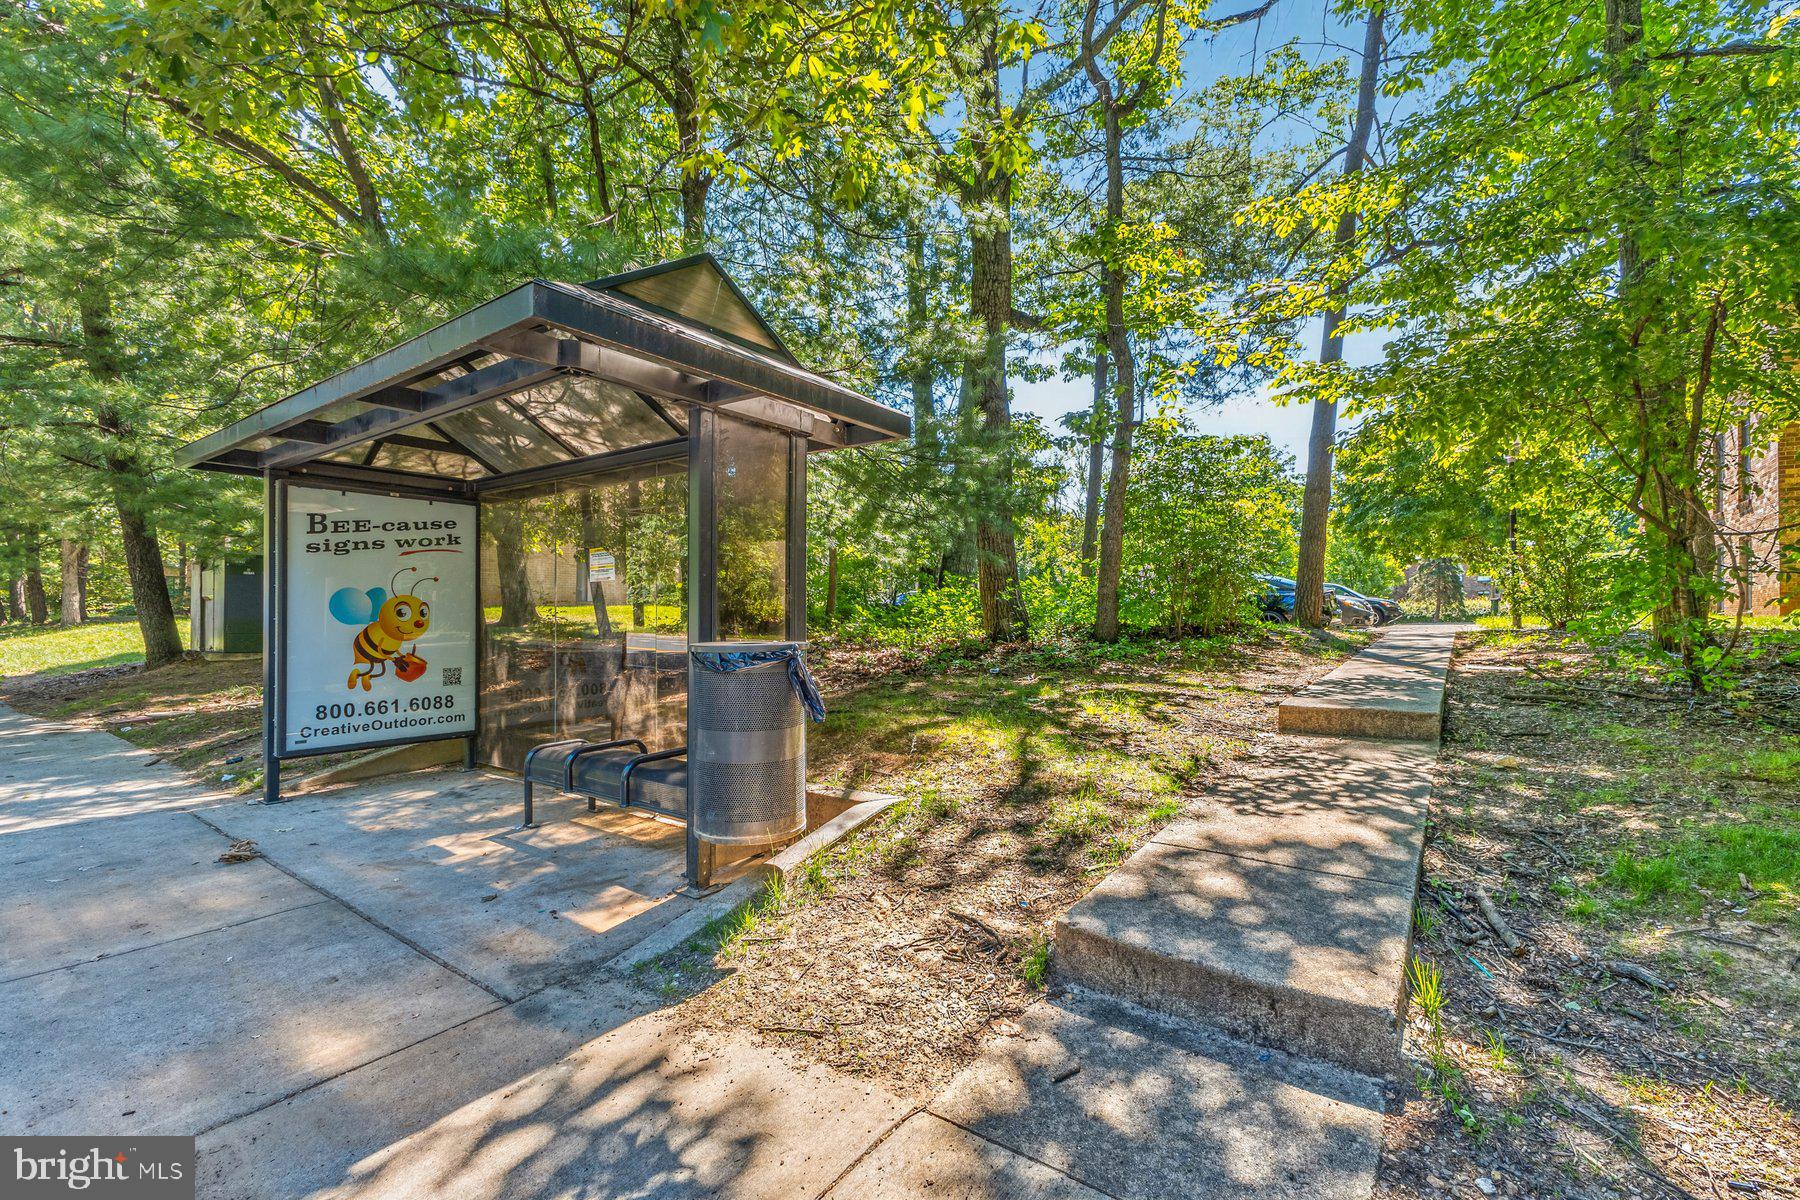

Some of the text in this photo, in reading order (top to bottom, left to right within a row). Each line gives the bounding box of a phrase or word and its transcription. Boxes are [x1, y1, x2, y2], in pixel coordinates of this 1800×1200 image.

[306, 513, 457, 534] BEE-cause
[306, 534, 462, 556] signs work
[315, 695, 454, 720] 800.661.6088
[300, 713, 466, 738] CreativeOutdoor.com
